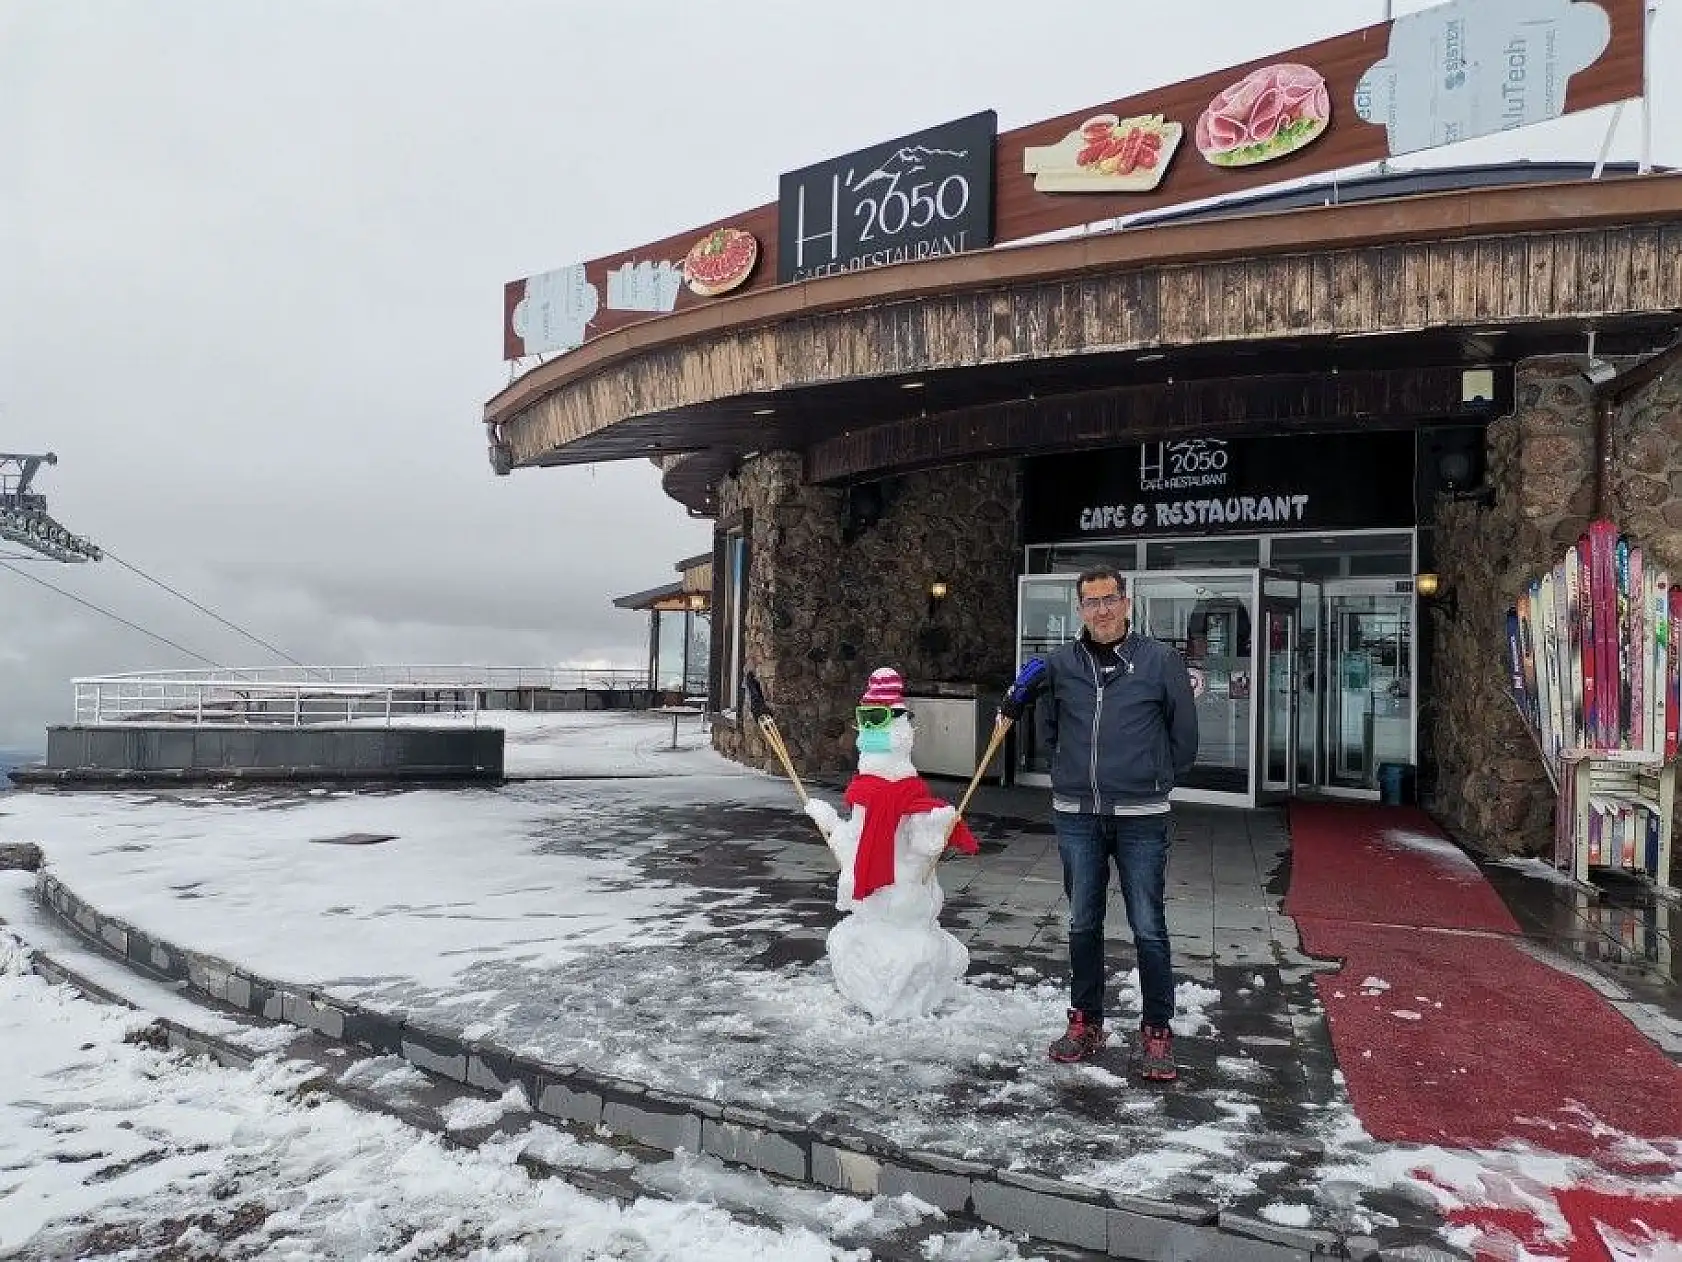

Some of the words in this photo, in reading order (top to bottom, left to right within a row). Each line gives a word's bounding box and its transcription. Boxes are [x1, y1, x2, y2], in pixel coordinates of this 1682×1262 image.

[854, 171, 970, 242] 2650
[1170, 473, 1227, 489] RESTAURANT
[1079, 503, 1127, 531] CAFE
[1131, 503, 1149, 528] &
[1155, 493, 1309, 528] RESTAURANT
